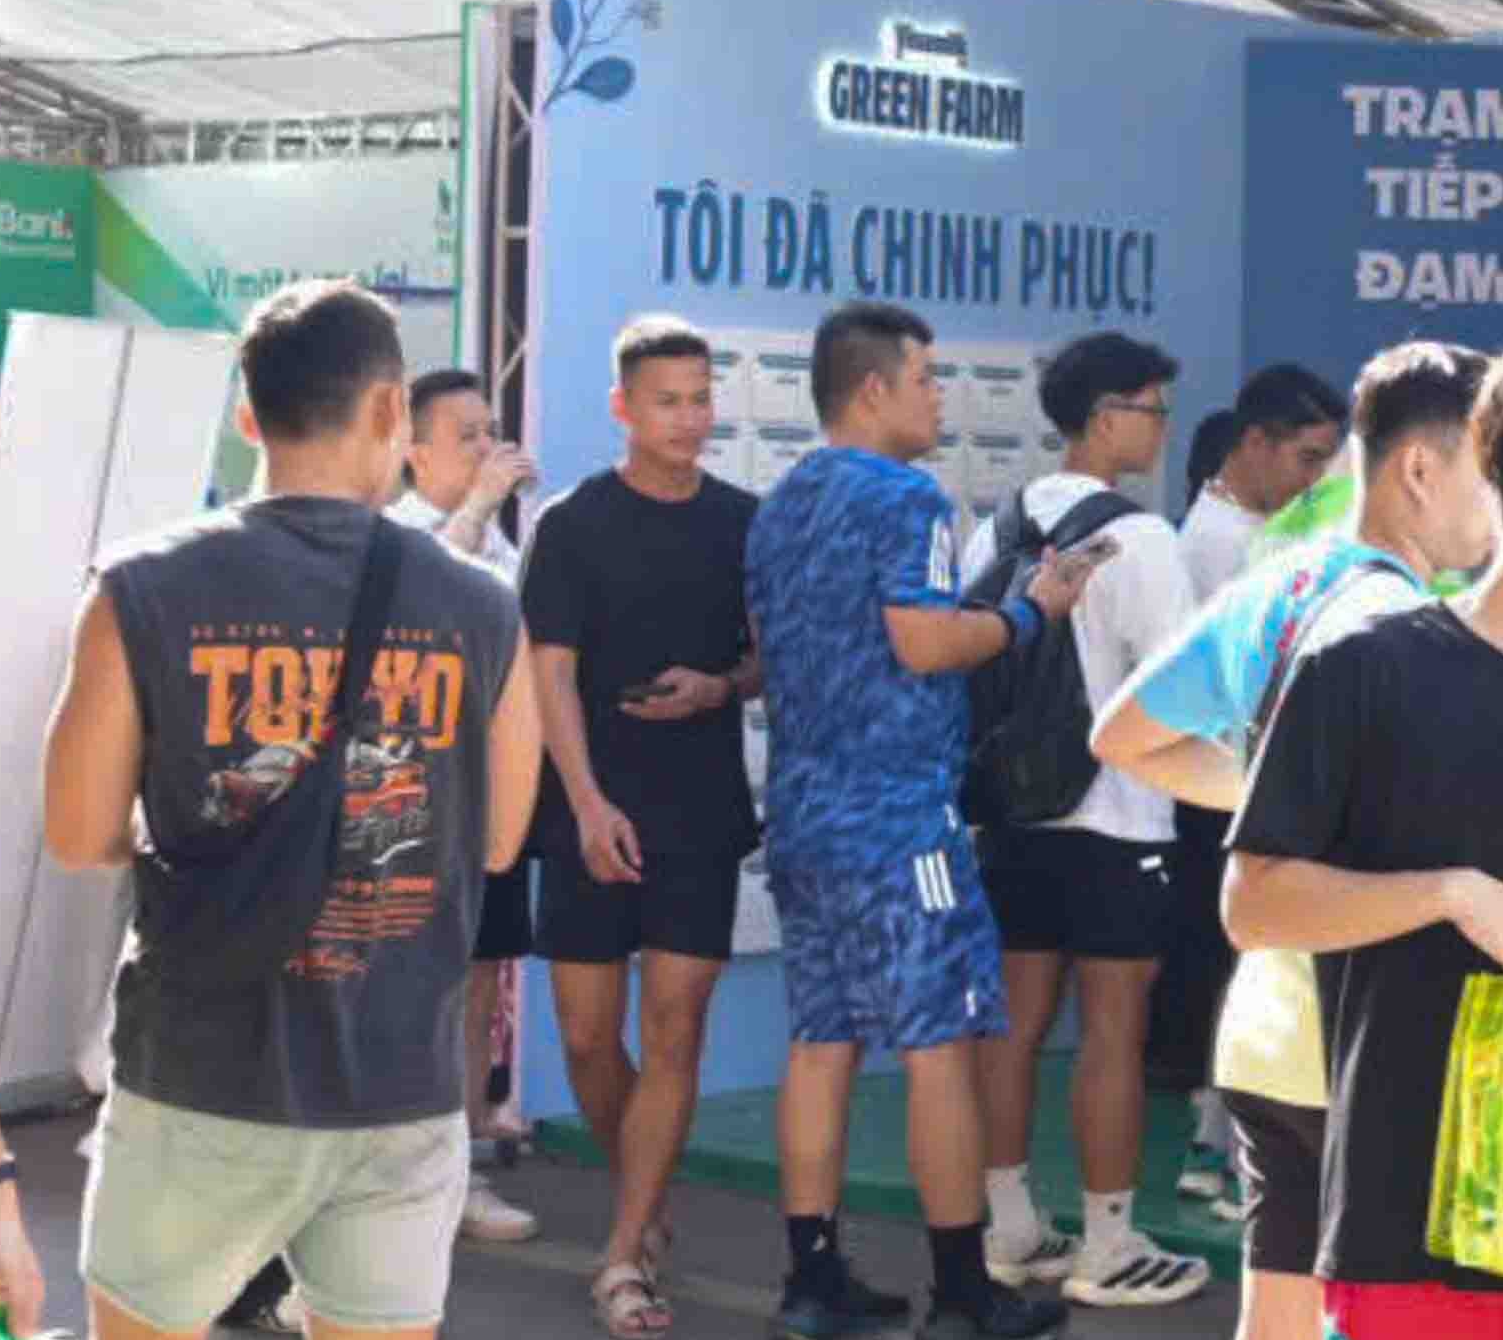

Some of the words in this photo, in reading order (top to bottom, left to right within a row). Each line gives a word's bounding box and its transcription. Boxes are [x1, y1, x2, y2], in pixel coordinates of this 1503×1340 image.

[830, 61, 930, 132] GREEN
[937, 76, 1025, 148] FARM
[654, 179, 744, 287] TÔI
[764, 190, 833, 294] ĐÃ
[852, 207, 998, 306] CHINH
